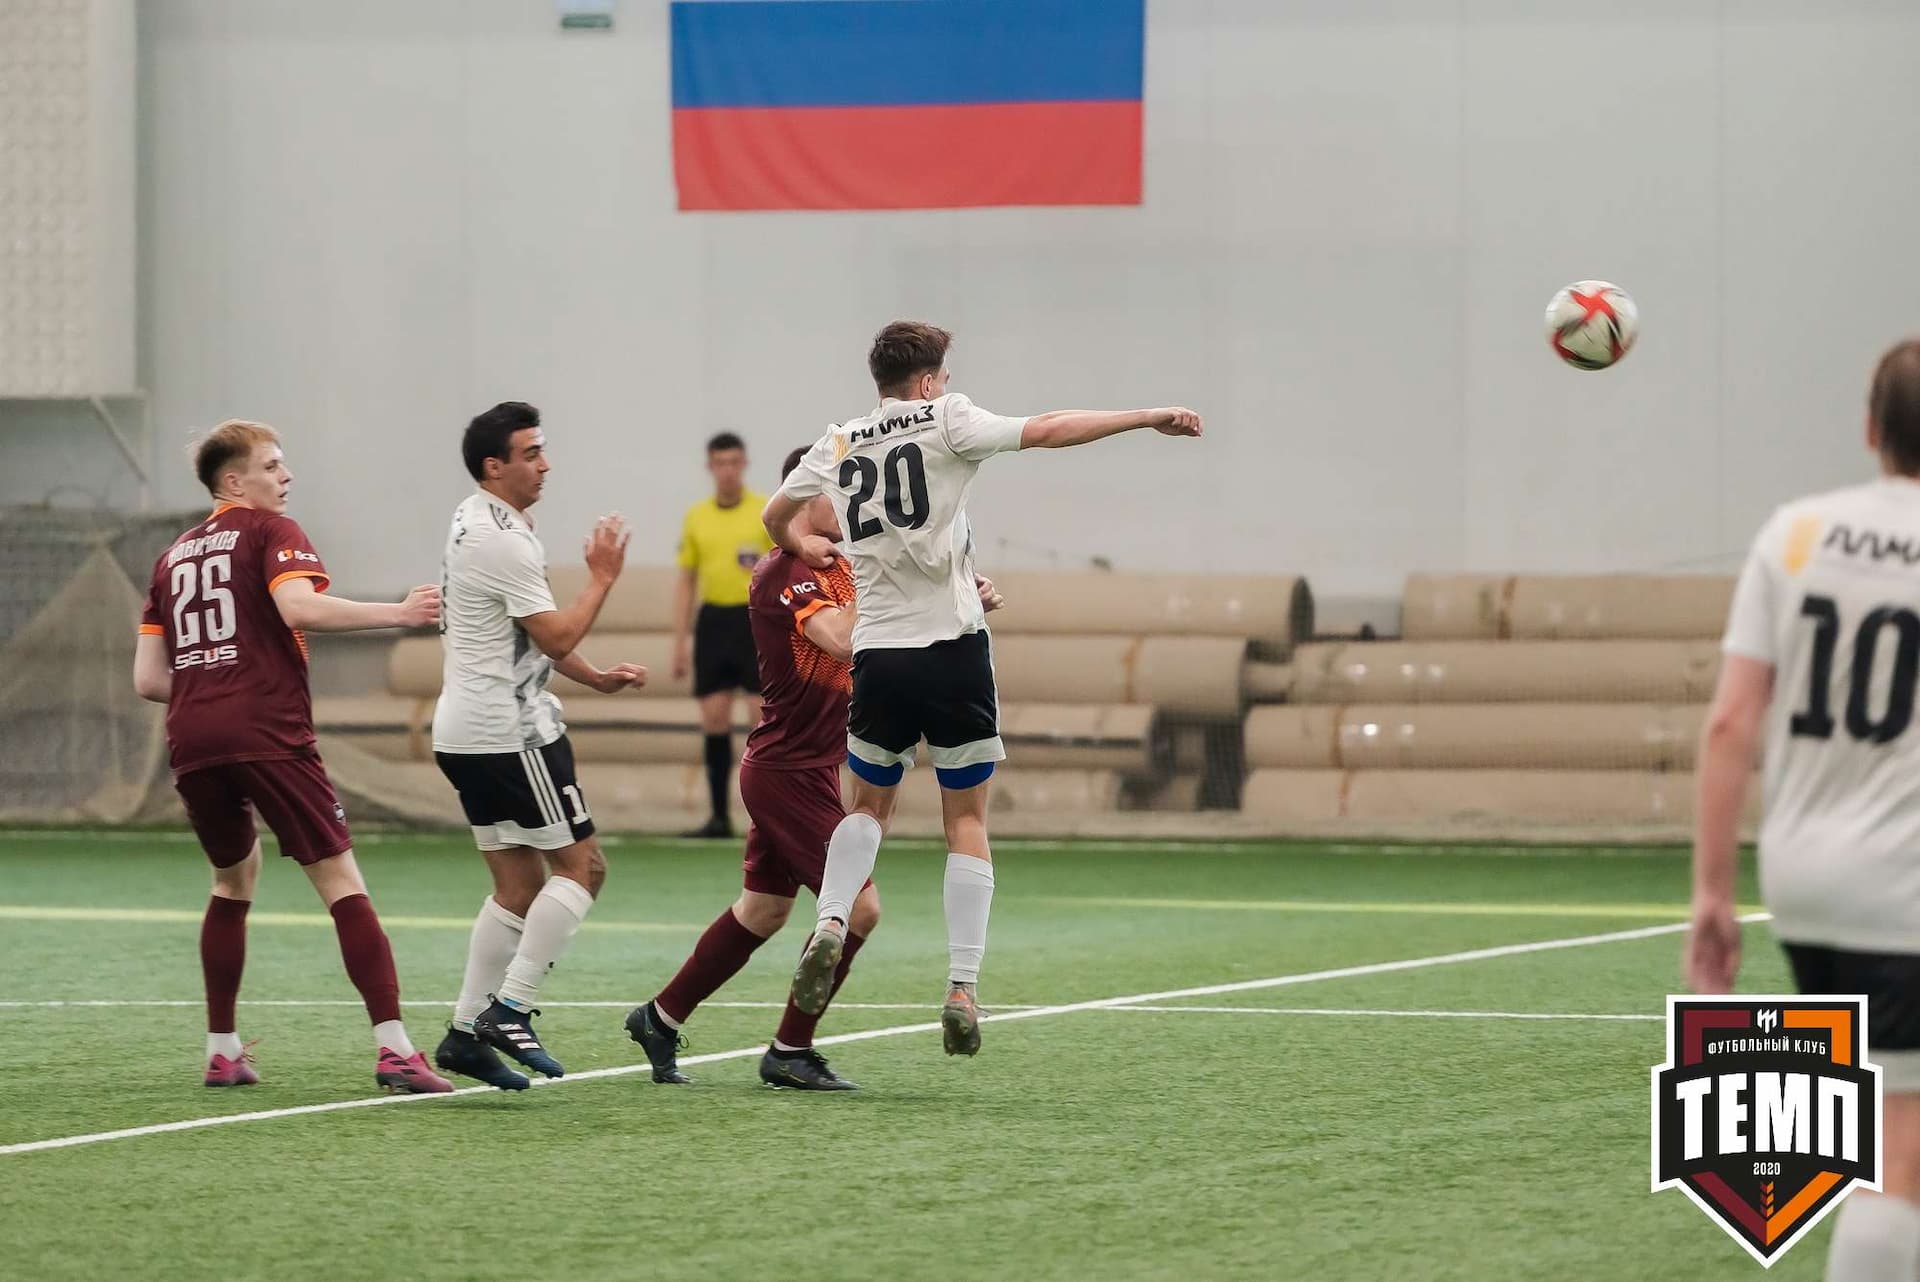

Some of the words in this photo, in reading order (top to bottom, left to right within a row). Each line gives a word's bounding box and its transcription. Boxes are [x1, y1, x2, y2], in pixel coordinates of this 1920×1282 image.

[839, 442, 930, 543] 20
[171, 554, 238, 649] 25
[174, 645, 238, 670] SEUS
[1790, 594, 1920, 744] 10
